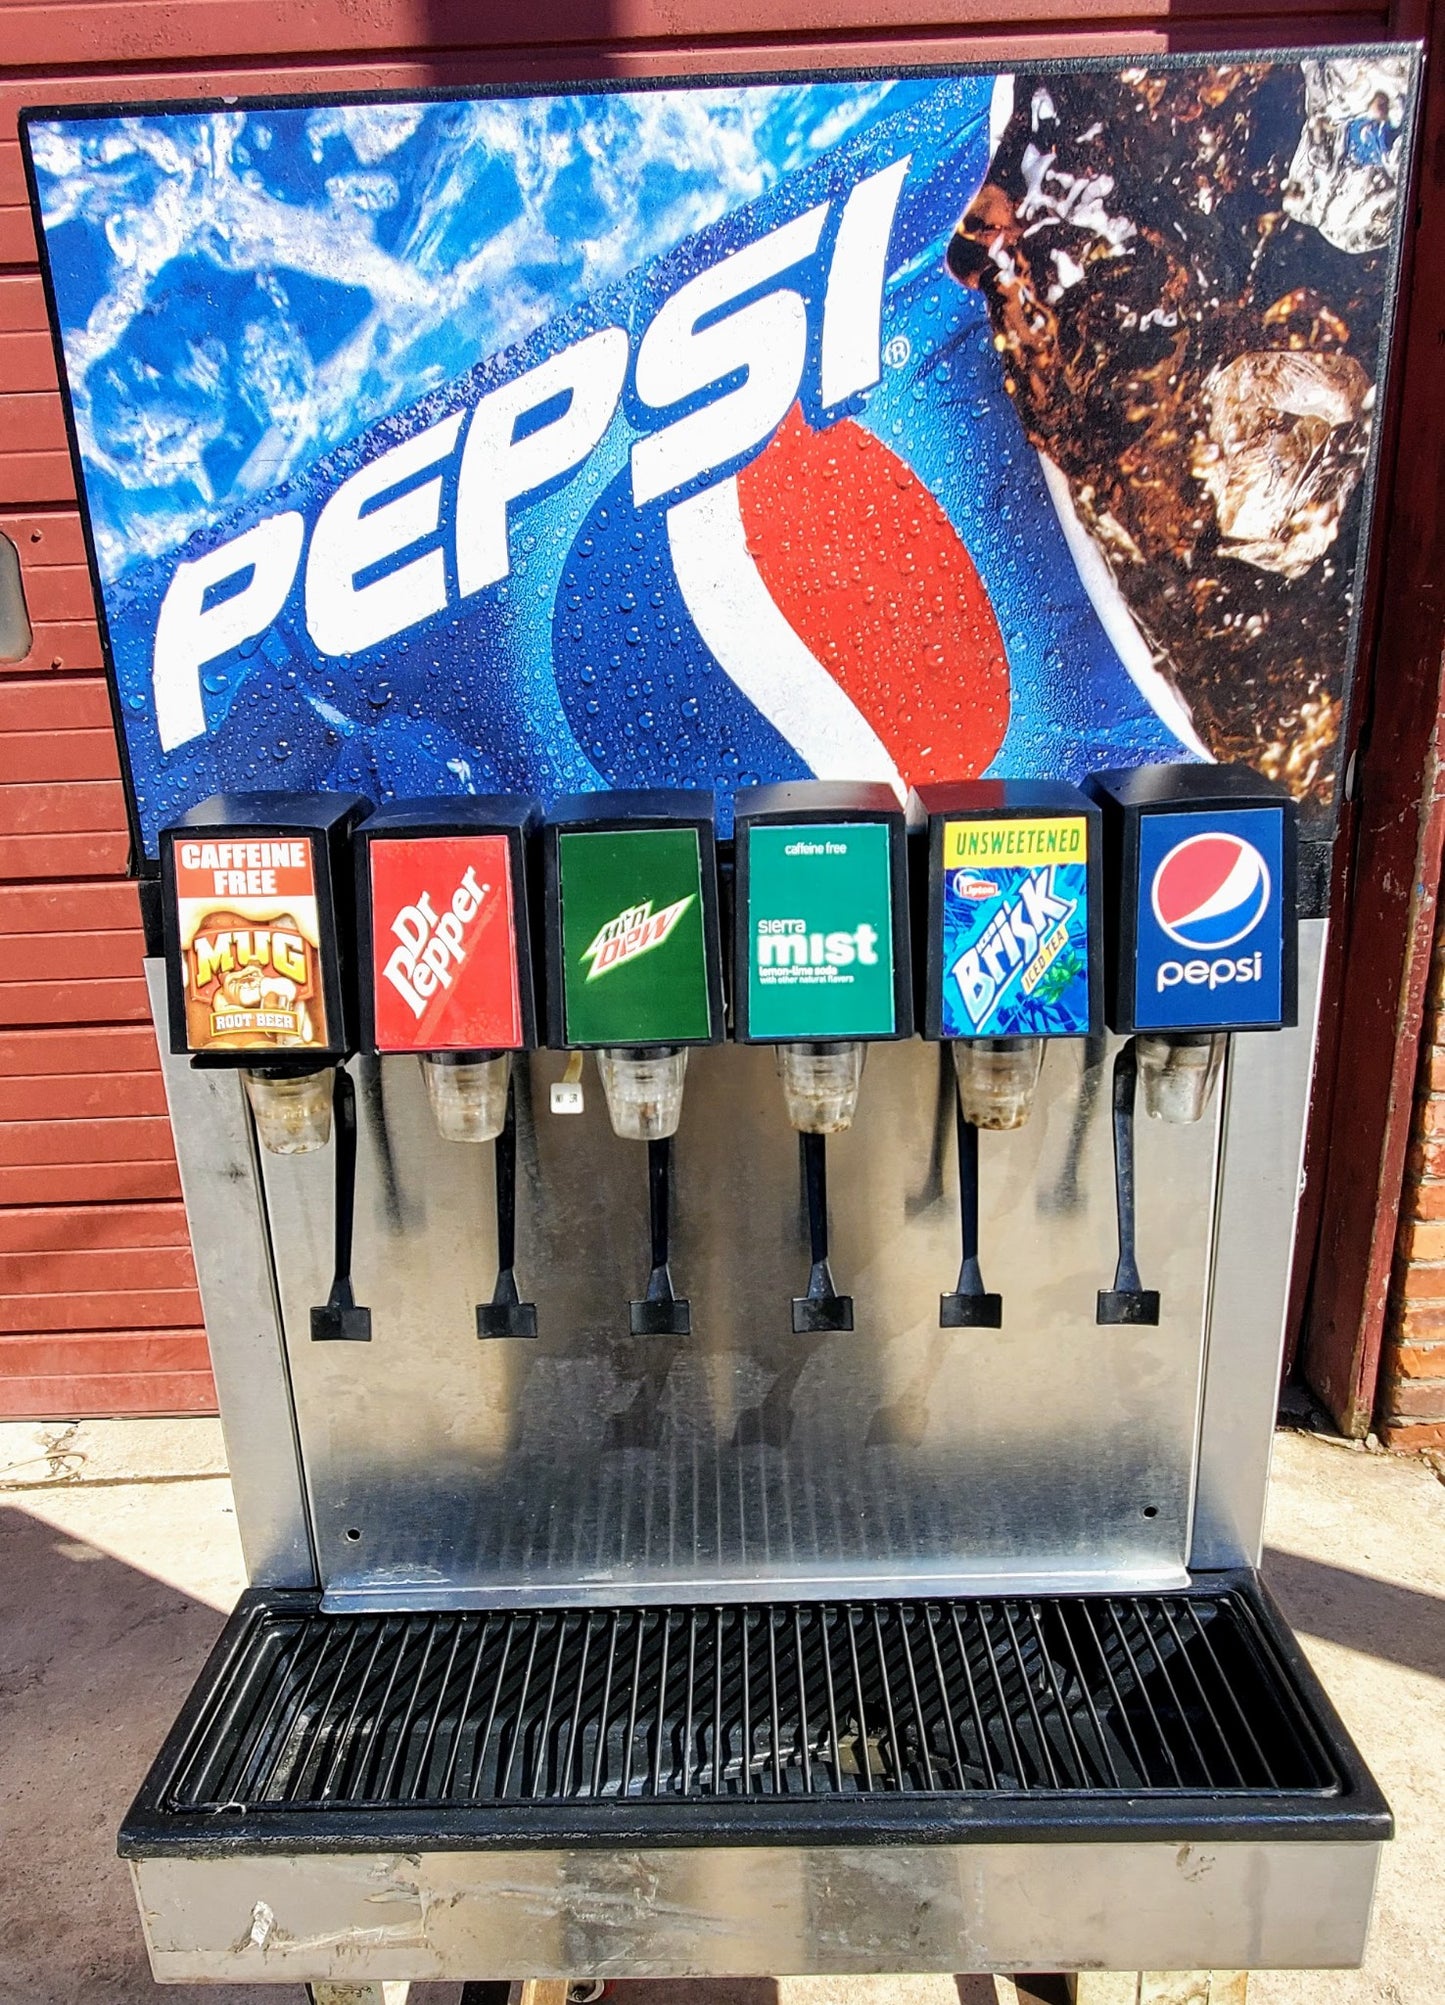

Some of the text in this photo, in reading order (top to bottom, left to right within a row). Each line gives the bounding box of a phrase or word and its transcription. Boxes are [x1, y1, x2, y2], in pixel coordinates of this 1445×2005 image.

[153, 153, 911, 753] PEPSI
[181, 843, 306, 869] CAFFEINE
[785, 841, 847, 855] caffeine free
[956, 828, 1080, 856] UNSWEETENED
[214, 870, 277, 894] FREE
[965, 885, 996, 897] Lipton
[390, 891, 439, 958] Dr
[758, 919, 806, 934] sierra
[757, 923, 878, 966] mist
[194, 931, 306, 987] MUG
[1024, 930, 1065, 989] ICED TEA
[1157, 952, 1262, 993] pepsi
[216, 1015, 294, 1029] ROOT BEER
